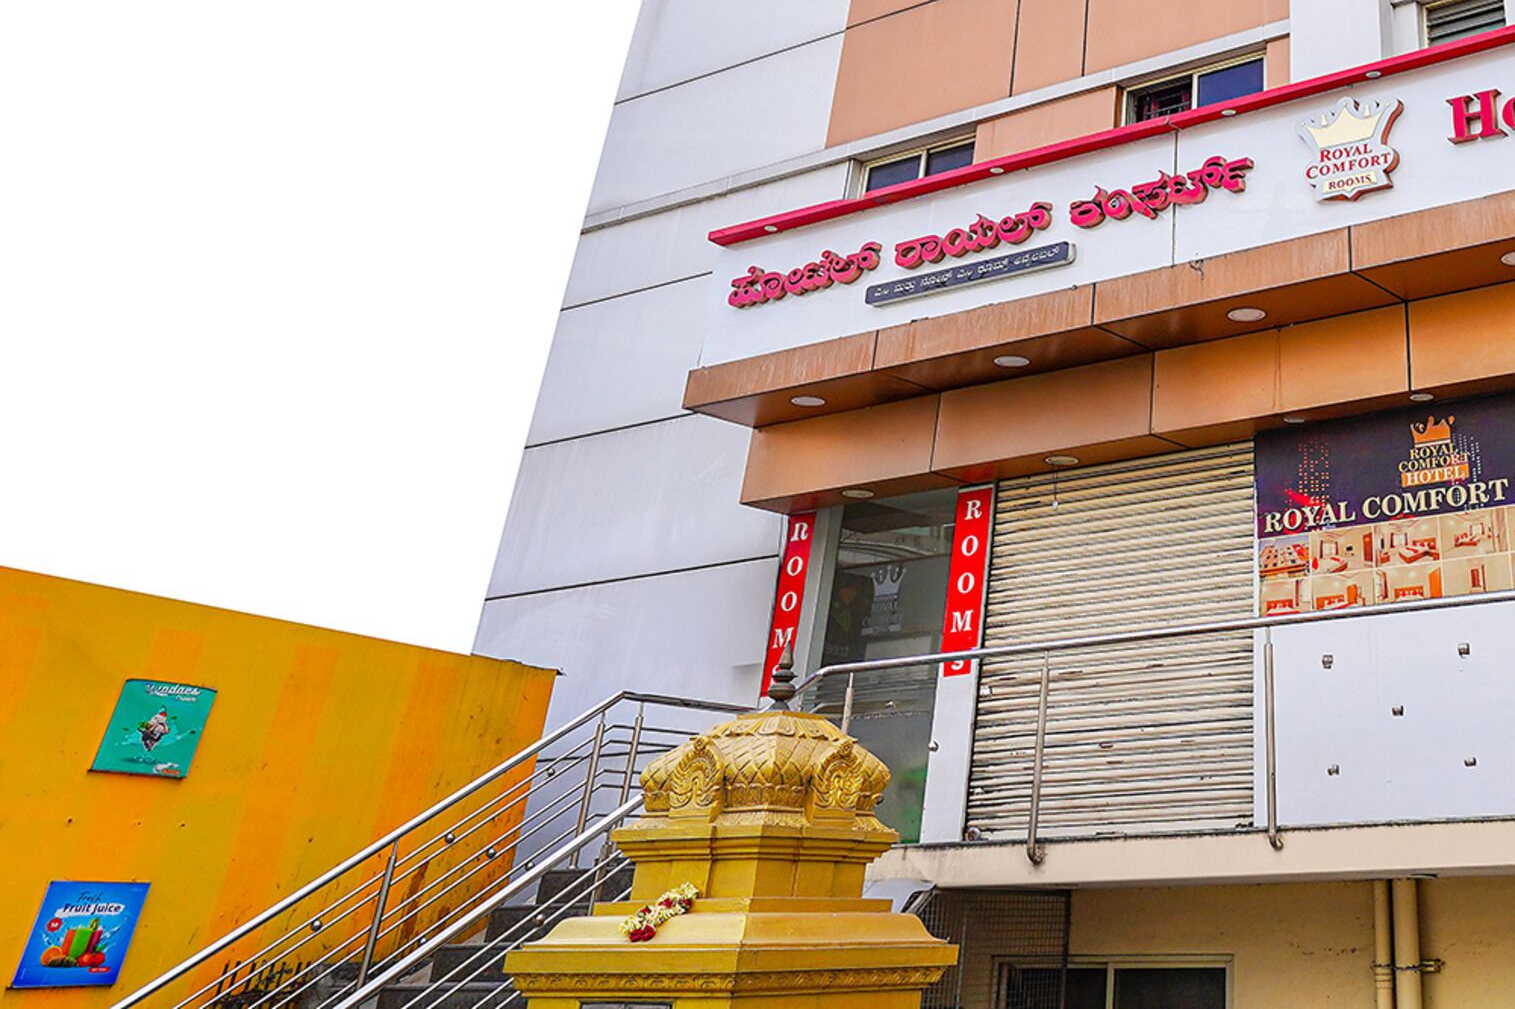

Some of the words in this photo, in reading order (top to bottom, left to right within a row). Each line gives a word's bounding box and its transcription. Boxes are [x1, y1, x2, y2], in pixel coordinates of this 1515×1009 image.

[1320, 143, 1373, 163] ROYAL
[1305, 152, 1391, 180] COMFORT
[1328, 174, 1372, 190] ROOMS
[895, 201, 1054, 270] ರಾಯಲ್
[1398, 451, 1471, 473] COMFORT
[1410, 442, 1458, 460] ROYAL
[1405, 465, 1466, 487] HOTEL
[1263, 501, 1356, 534] ROYAL
[1361, 477, 1510, 519] COMFORT
[771, 521, 809, 685] ROOM
[62, 903, 91, 913] Fruit
[91, 902, 121, 915] Juice
